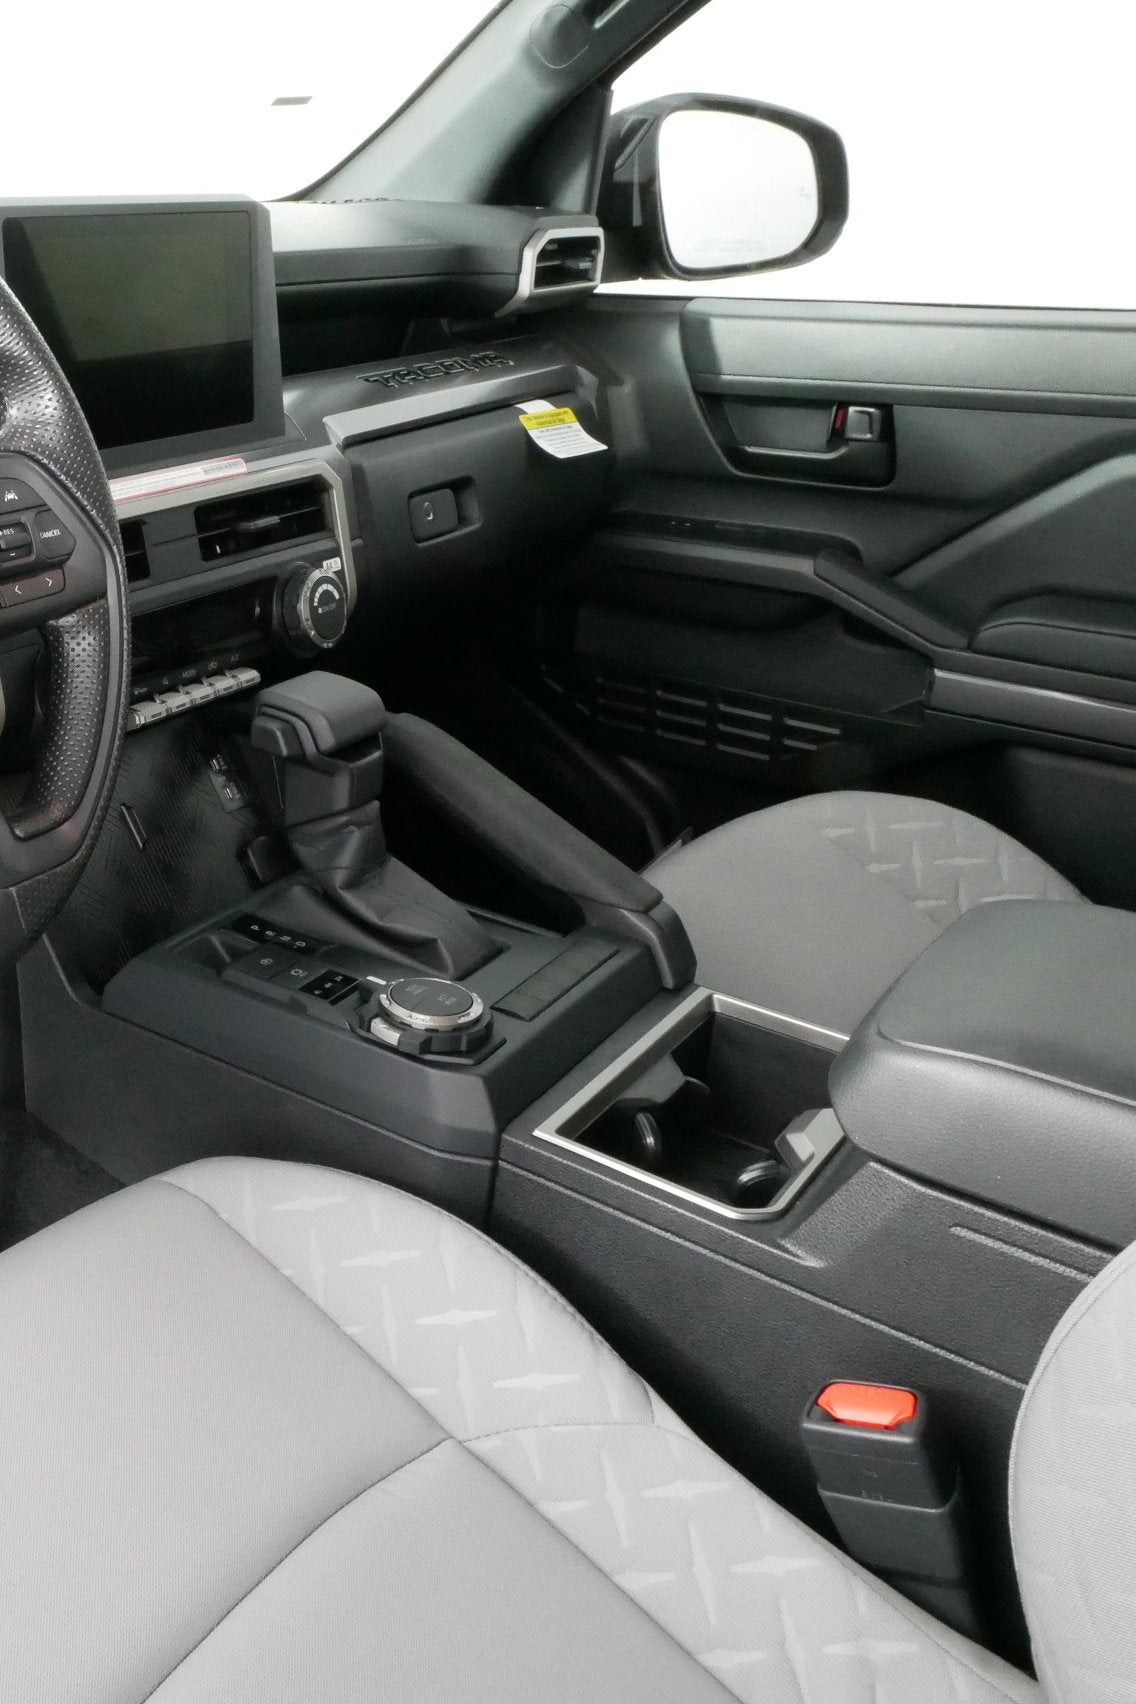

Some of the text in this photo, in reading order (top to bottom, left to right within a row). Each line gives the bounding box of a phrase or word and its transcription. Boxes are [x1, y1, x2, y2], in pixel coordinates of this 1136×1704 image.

[355, 350, 515, 389] TACOMA
[39, 528, 62, 540] CANCEL
[250, 923, 261, 932] P
